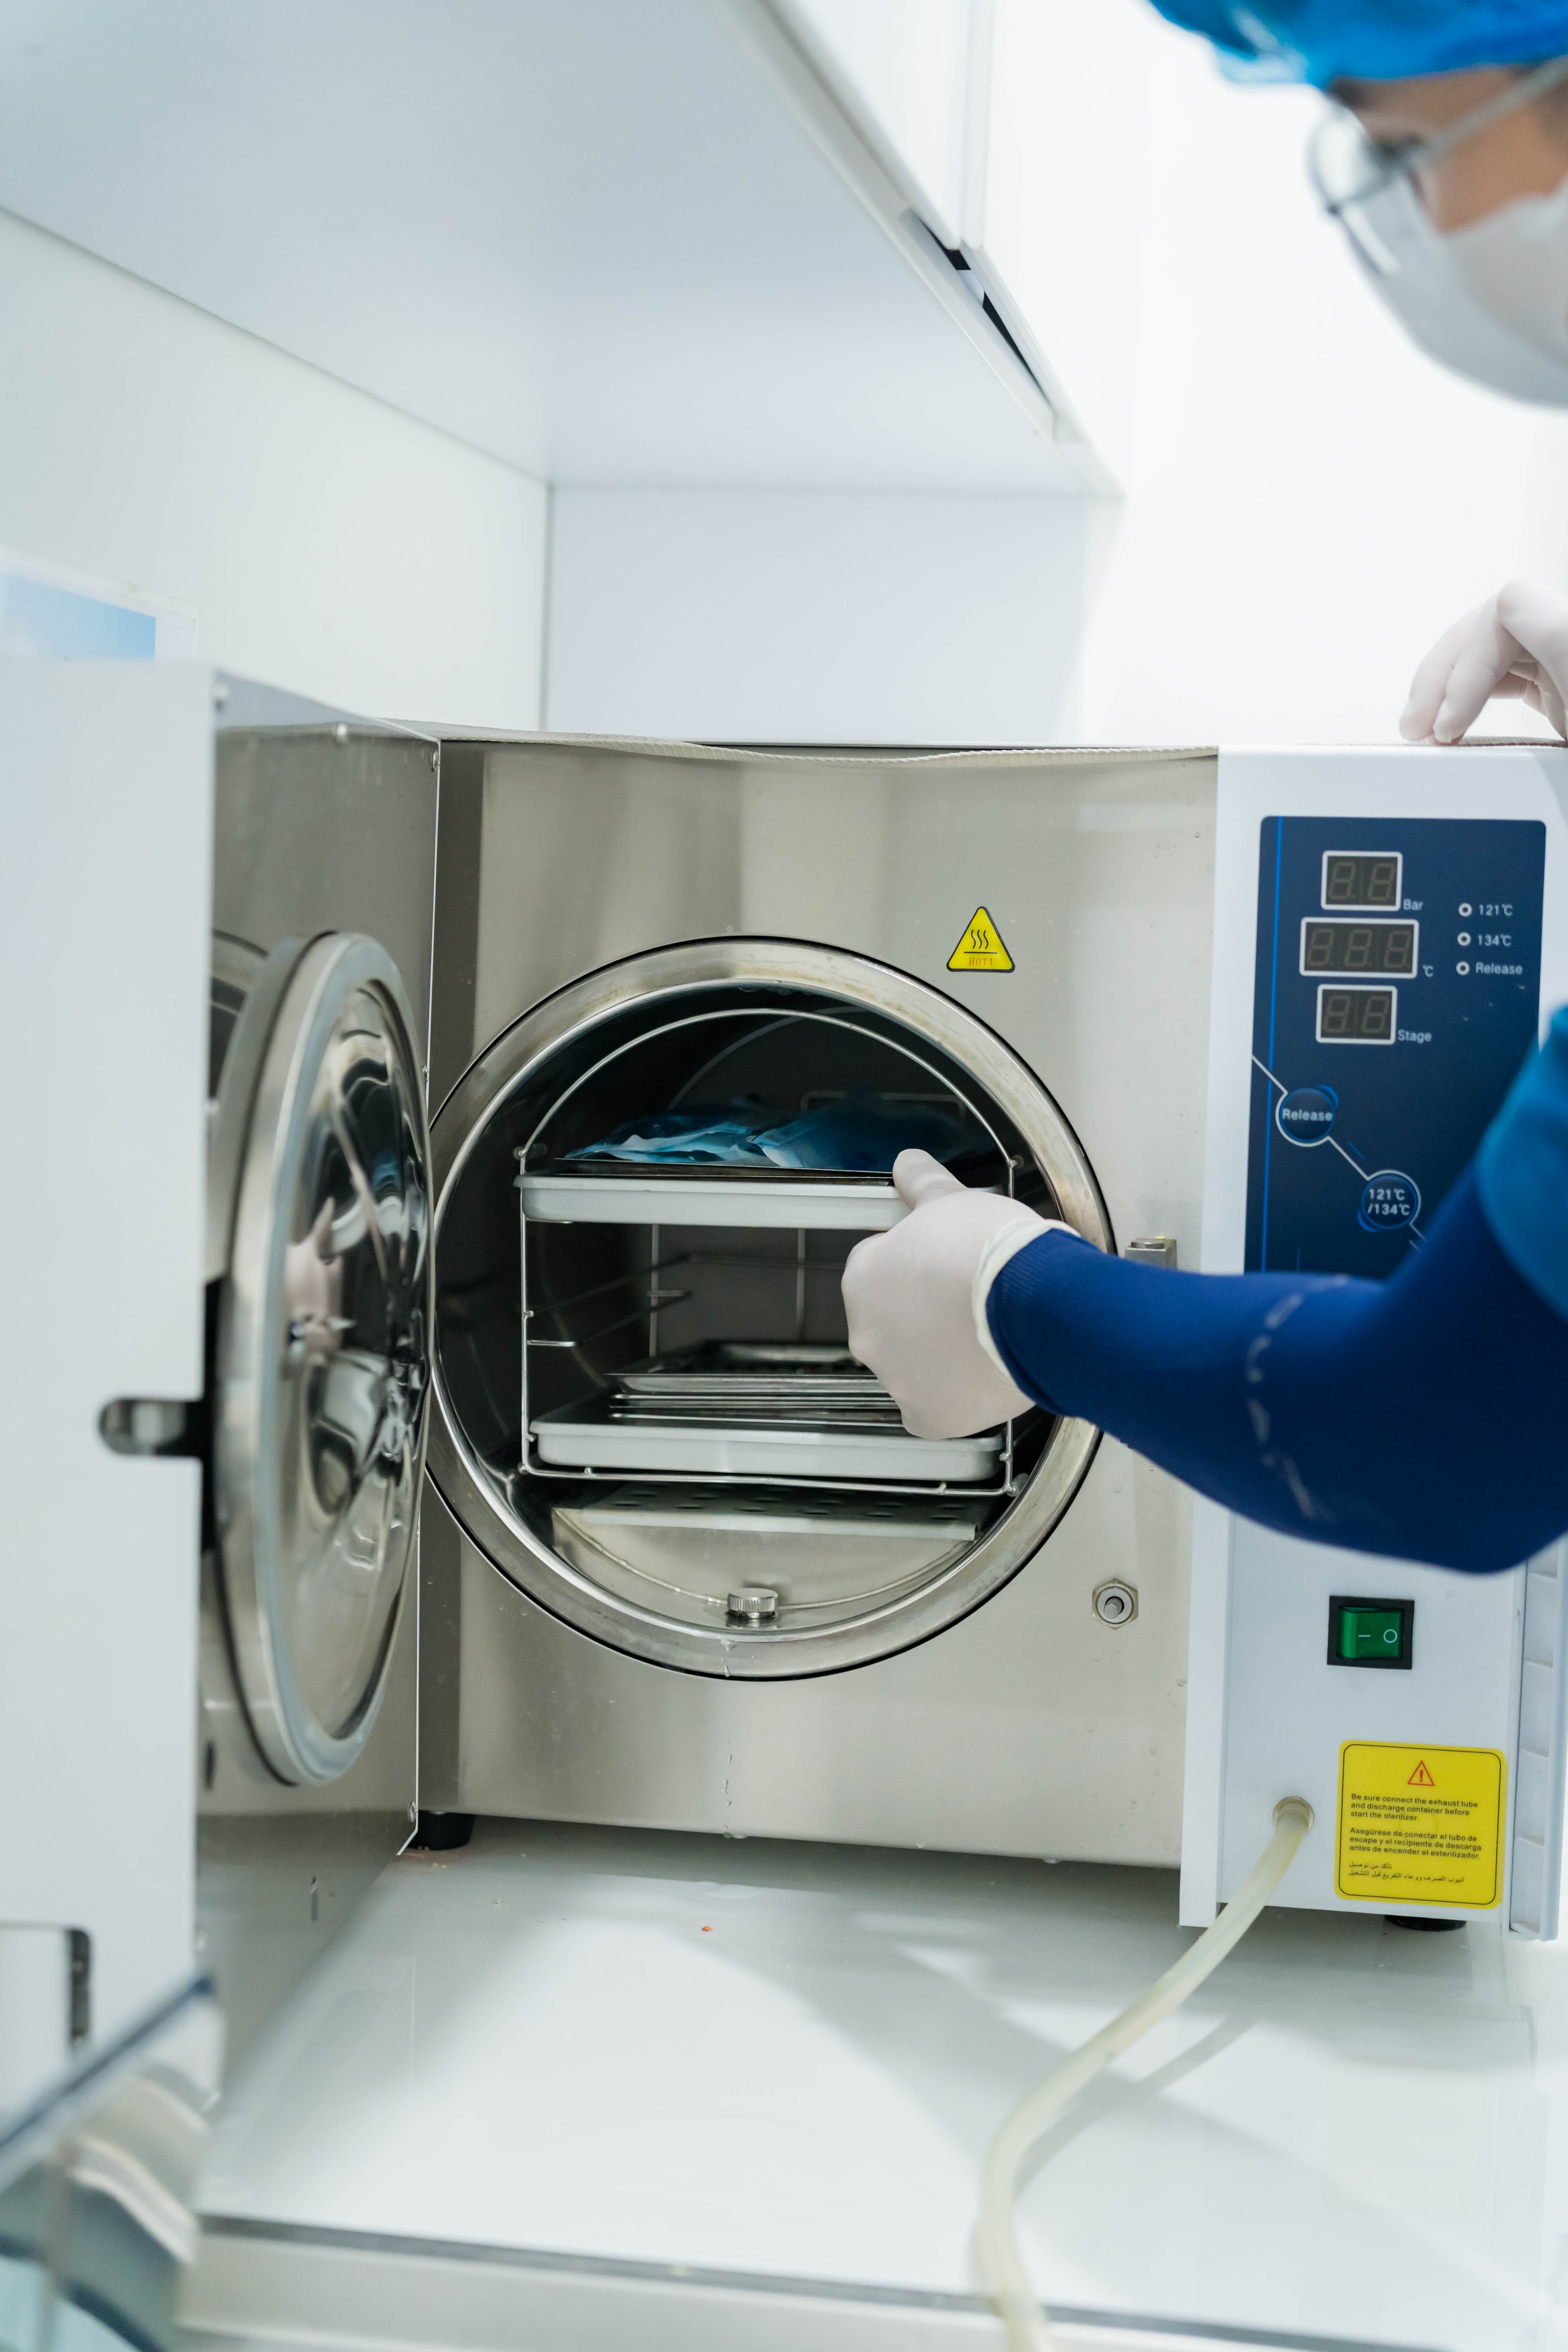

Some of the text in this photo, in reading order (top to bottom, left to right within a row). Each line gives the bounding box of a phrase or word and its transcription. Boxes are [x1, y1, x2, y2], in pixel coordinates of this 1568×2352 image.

[1404, 899, 1423, 910] Bar
[1475, 963, 1523, 975] Release
[1398, 1030, 1432, 1044] Stage
[1282, 1109, 1333, 1121] Release
[1367, 1804, 1405, 1812] discharge
[1350, 1828, 1391, 1836] Asegúrese
[1446, 1843, 1481, 1851] descarga
